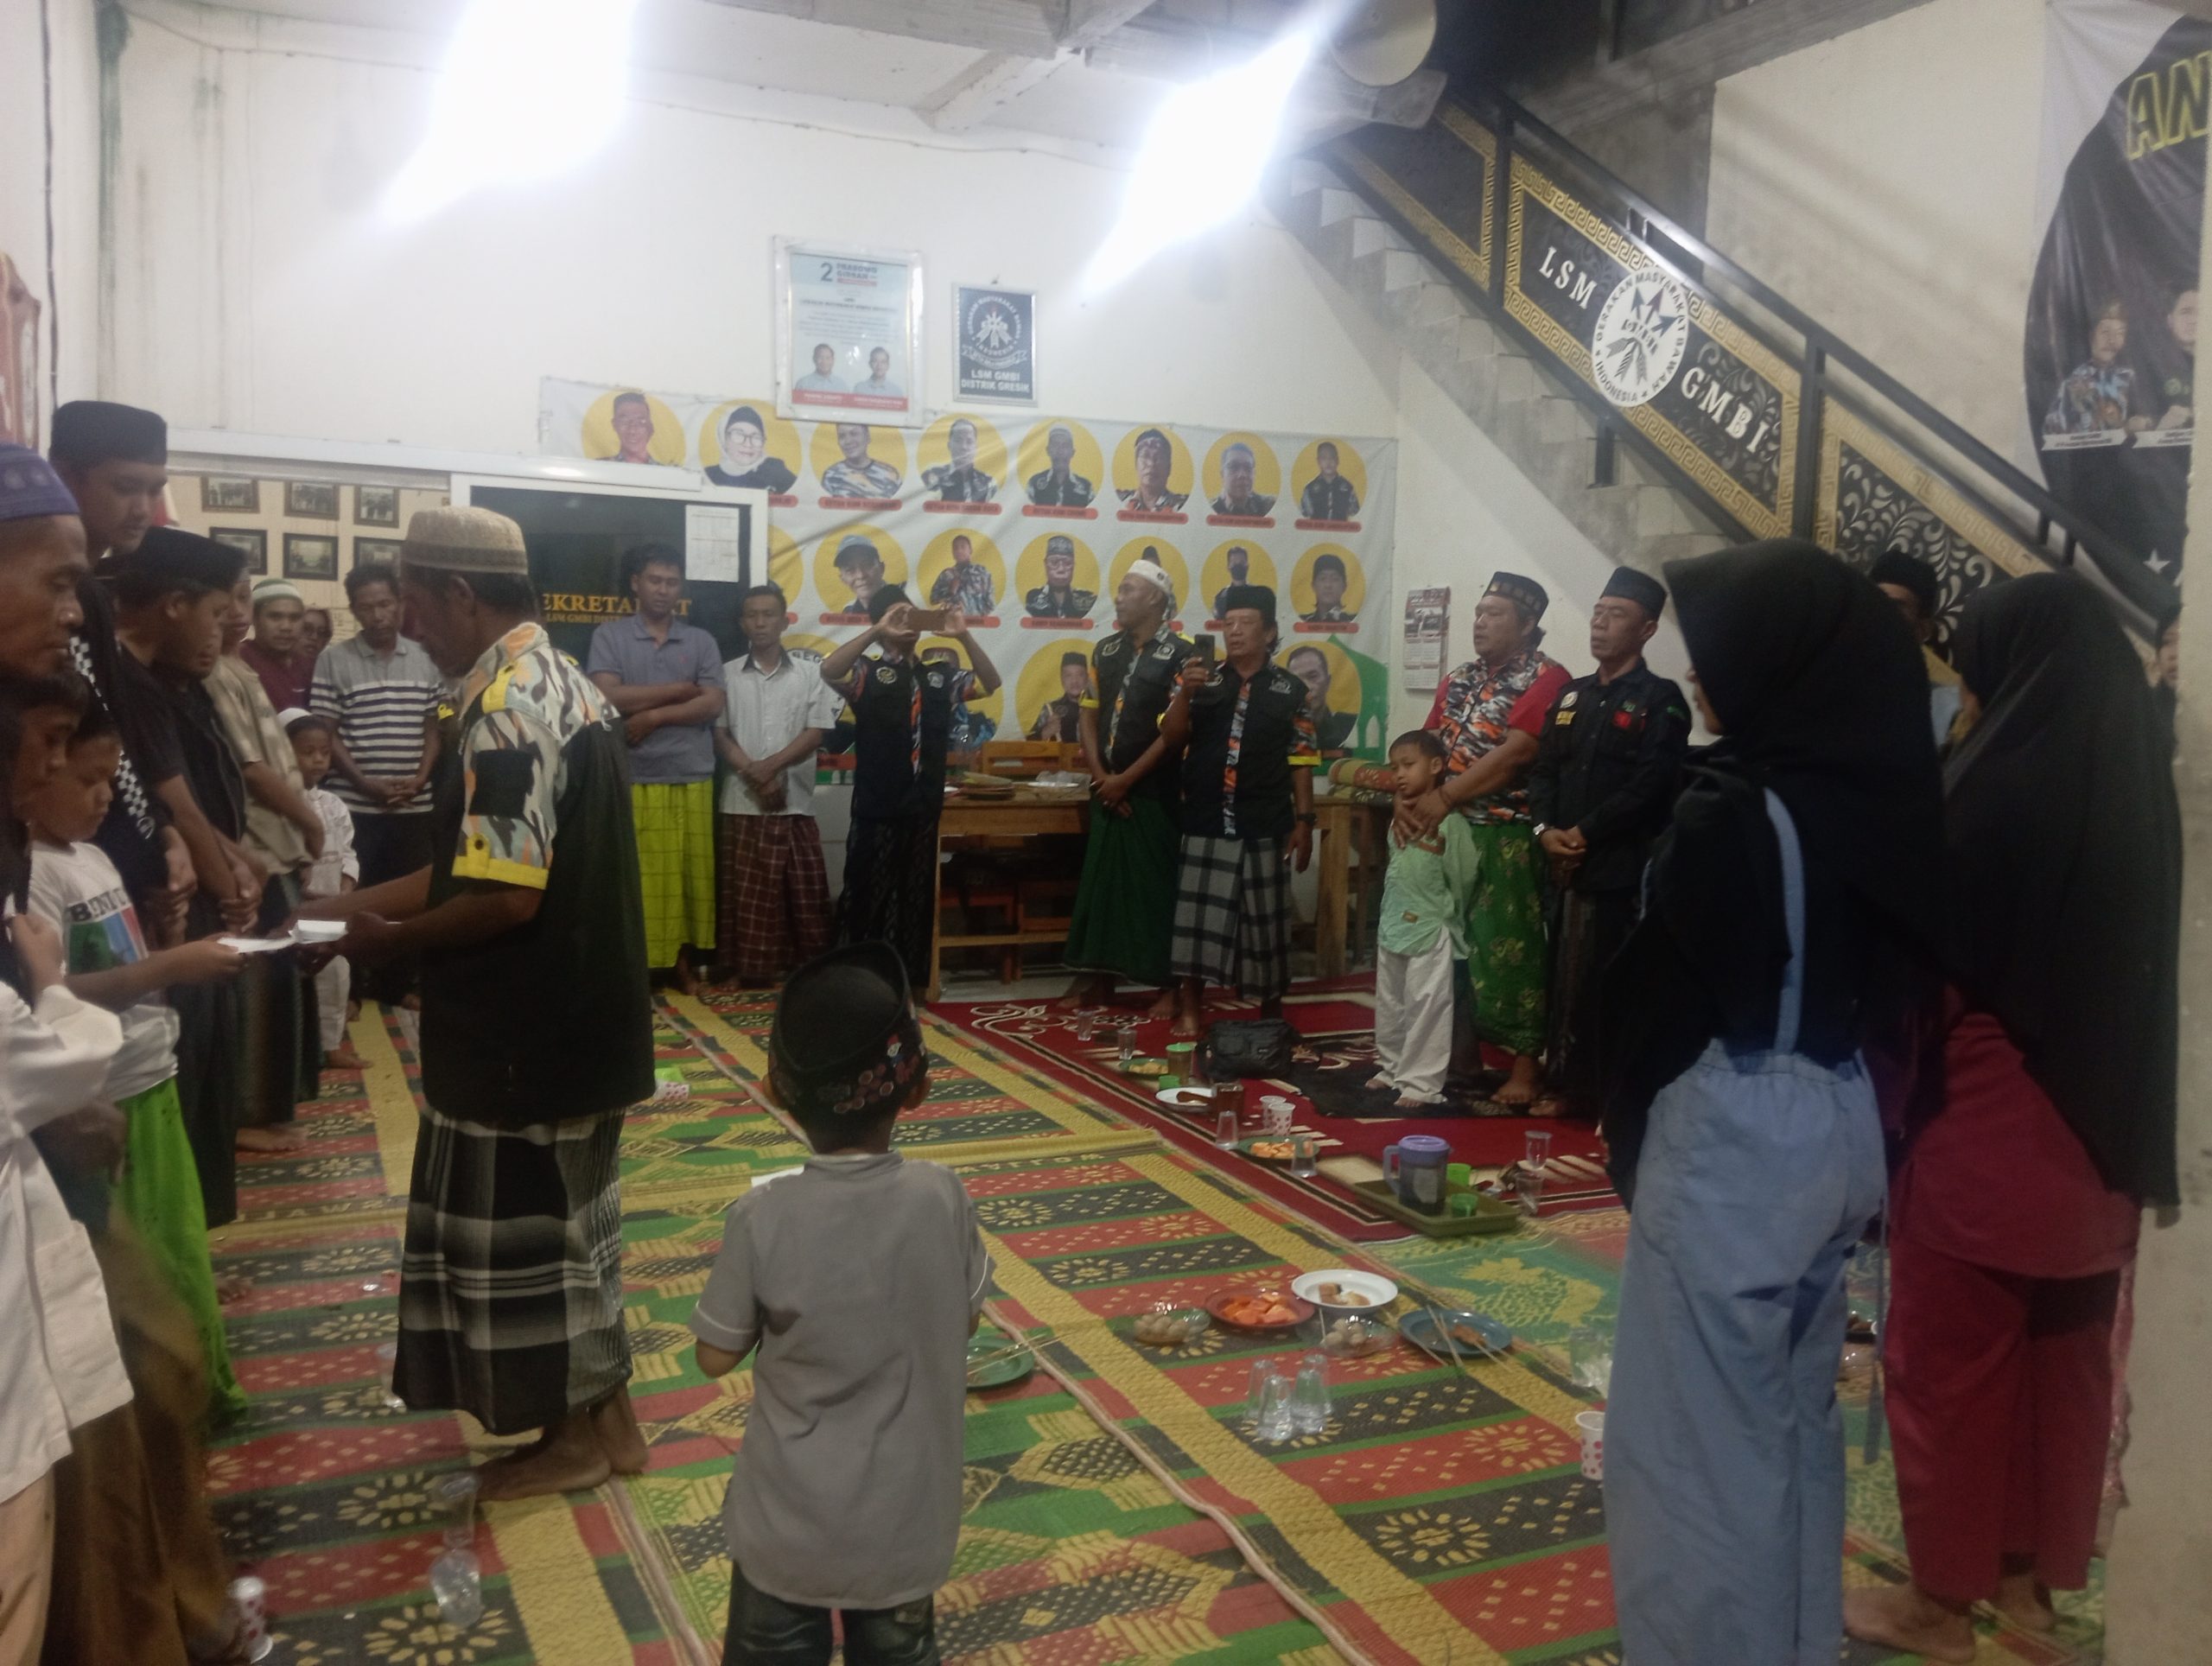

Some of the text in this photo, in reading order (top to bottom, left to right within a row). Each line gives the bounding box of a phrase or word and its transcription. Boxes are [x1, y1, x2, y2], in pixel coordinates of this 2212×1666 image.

[820, 262, 833, 283] 2
[1539, 246, 1598, 309] LSM
[1596, 272, 1686, 389] GERAKAN MASYARAKAT BAWAH
[961, 379, 1030, 392] DISTRIK GRESIK
[971, 369, 1020, 381] LSM GMBI
[1595, 360, 1638, 402] INDONESIA
[1681, 366, 1770, 454] GMBI
